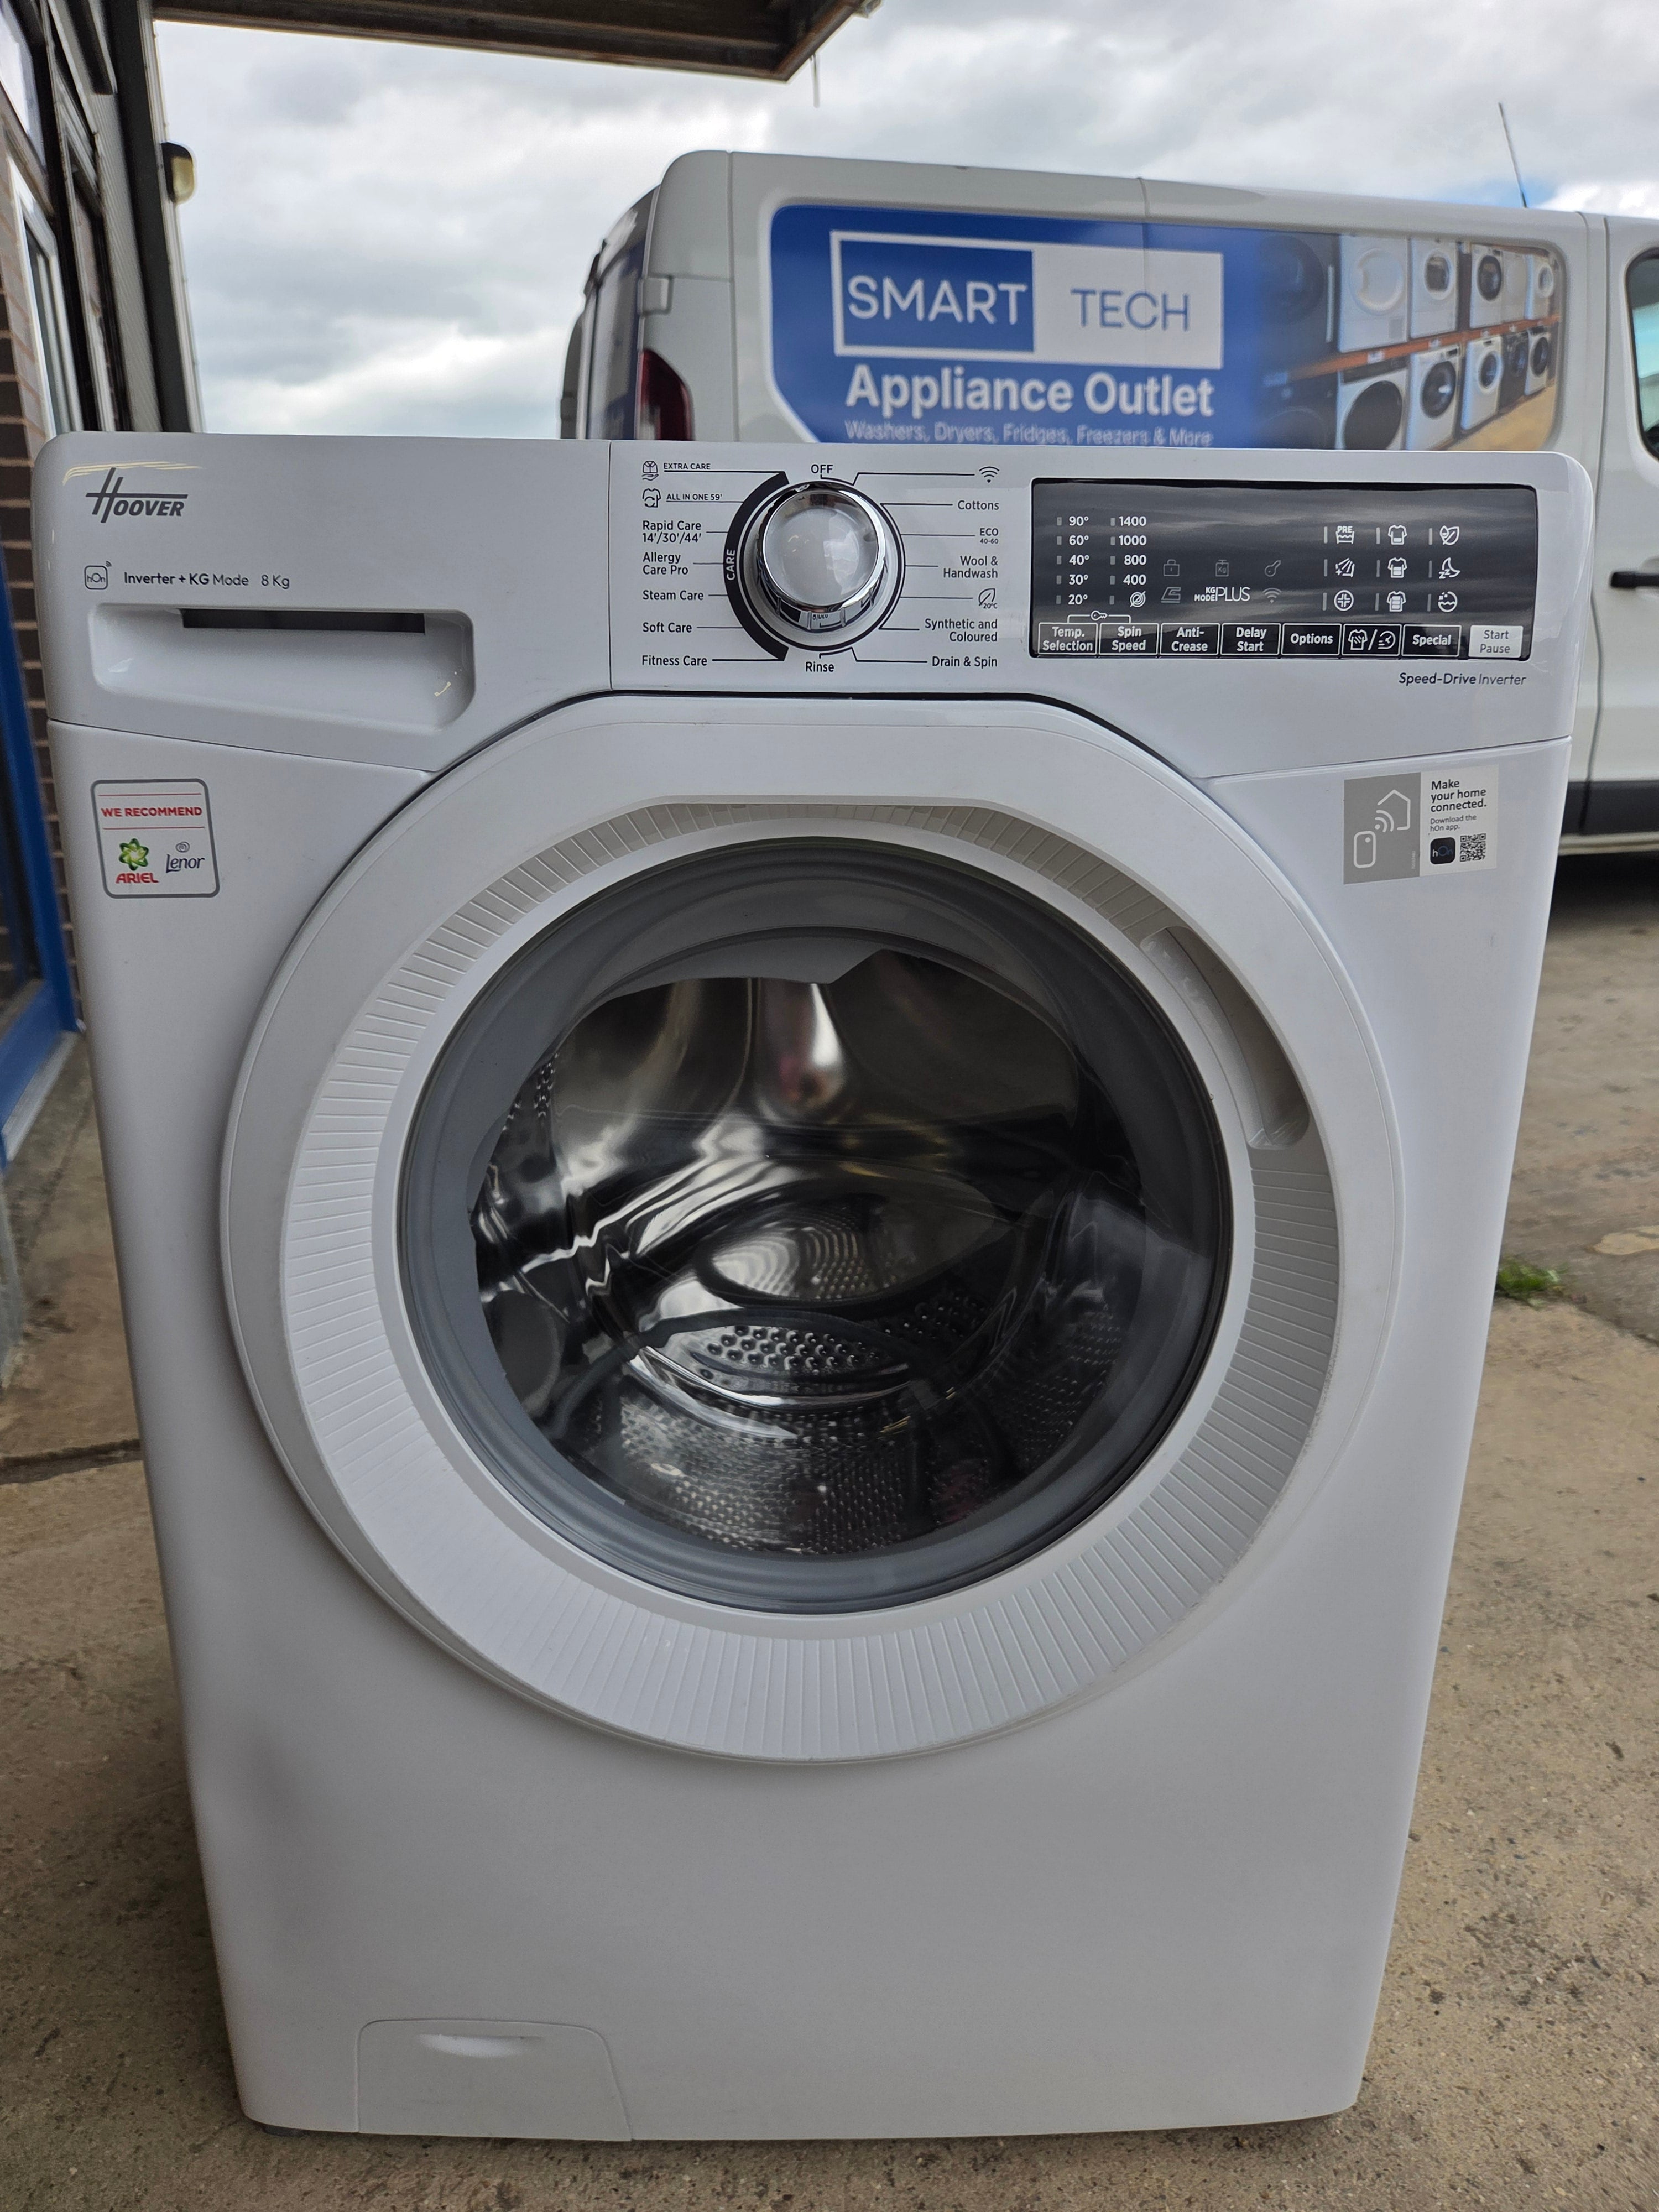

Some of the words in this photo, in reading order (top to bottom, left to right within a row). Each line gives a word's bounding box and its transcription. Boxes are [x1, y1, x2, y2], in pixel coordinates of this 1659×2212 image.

[847, 275, 1028, 325] SMART
[1071, 288, 1191, 332] TECH
[846, 364, 1073, 419] Appliance
[1084, 372, 1214, 417] Outlet
[844, 419, 930, 442] Washers,
[934, 421, 999, 443] Dryers,
[1003, 422, 1073, 444] Fridges,
[1077, 424, 1150, 445] Freezers
[1154, 426, 1166, 445] &
[1169, 426, 1214, 446] More
[811, 464, 833, 474] OFF
[86, 467, 189, 523] HOOVER
[958, 500, 999, 510] Cottons
[643, 520, 674, 532] Rapid
[677, 520, 702, 530] Care
[1068, 516, 1089, 526] 90°
[1119, 516, 1147, 526] 1400
[980, 528, 999, 536] ECO
[1068, 535, 1089, 546] 60°
[1119, 535, 1147, 546] 1000
[643, 552, 681, 565] Allergy
[960, 555, 988, 566] Wool
[991, 556, 998, 566] &
[1068, 555, 1089, 565] 40°
[1124, 555, 1147, 565] 800
[643, 565, 667, 575] Care
[670, 565, 688, 575] Pro
[726, 549, 735, 581] CARE
[943, 568, 998, 578] Handwash
[124, 572, 176, 584] Inverter
[178, 575, 186, 583] +
[189, 573, 210, 585] KG
[213, 573, 249, 586] Mode
[261, 575, 269, 586] 8
[273, 575, 290, 590] Kg
[1068, 574, 1089, 585] 30°
[1123, 574, 1147, 585] 400
[643, 590, 676, 601] Steam
[680, 590, 704, 601] Care
[1068, 594, 1088, 605] 20°
[1215, 586, 1251, 602] PLUS
[643, 622, 665, 633] Soft
[668, 623, 692, 633] Care
[925, 618, 975, 630] Synthetic
[978, 619, 998, 629] and
[950, 632, 998, 642] Coloured
[1052, 627, 1085, 638] Temp.
[1117, 626, 1142, 639] Spin
[1176, 627, 1204, 638] Anti-
[1236, 627, 1267, 640] Delay
[1484, 629, 1509, 640] Start
[1290, 633, 1333, 646] Options
[1412, 634, 1452, 647] Special
[1042, 640, 1093, 652] Selection
[1112, 640, 1146, 653] Speed
[1171, 641, 1208, 652] Crease
[1237, 641, 1264, 652] Start
[1480, 644, 1511, 654] Pause
[641, 655, 680, 666] Fitness
[683, 655, 708, 666] Care
[932, 656, 960, 667] Drain
[963, 656, 971, 667] &
[974, 656, 998, 669] Spin
[806, 661, 835, 672] Rinse
[1399, 672, 1477, 687] Speed-Drive
[1478, 673, 1527, 686] Inverter
[1431, 779, 1460, 790] Make
[1431, 792, 1455, 804] your
[1457, 789, 1486, 799] home
[1431, 798, 1488, 813] connected.
[101, 807, 123, 817] WE
[124, 807, 203, 817] RECOMMEND
[1430, 815, 1464, 825] Download
[1432, 846, 1453, 858] hOn
[165, 854, 205, 874] Lenor
[115, 873, 159, 884] ARIEL
